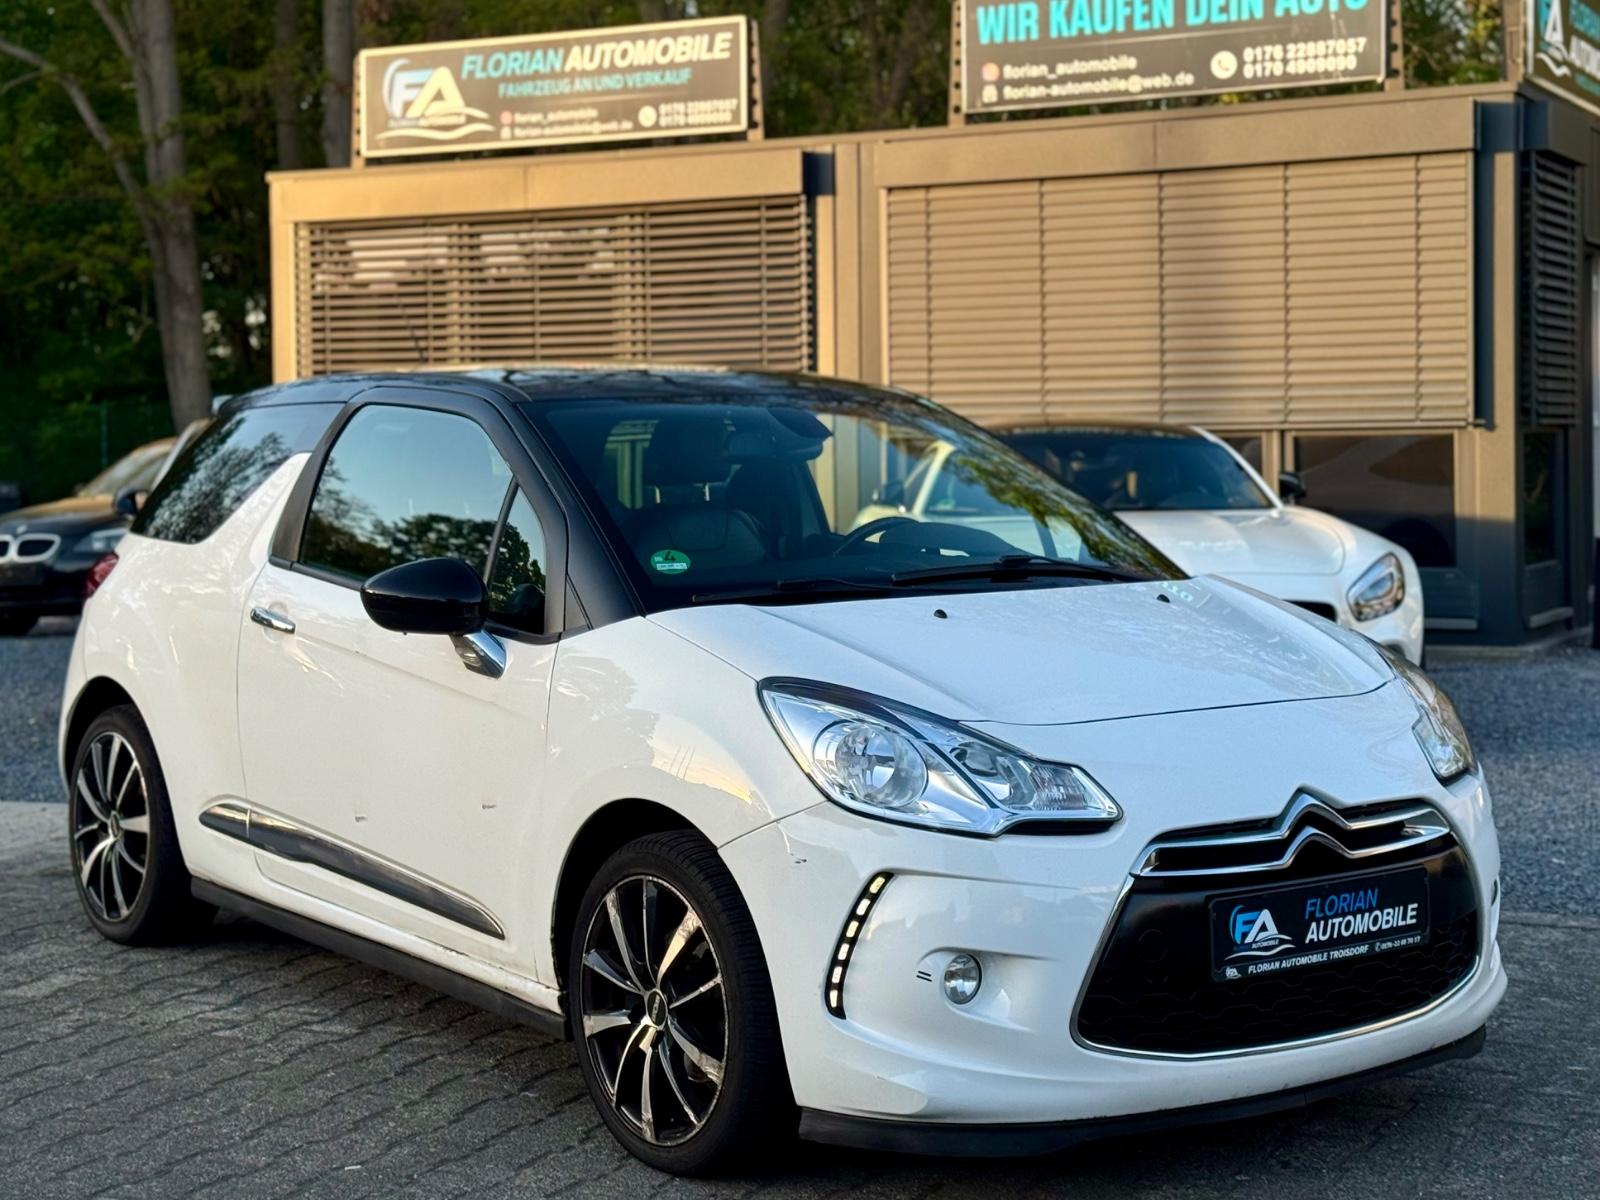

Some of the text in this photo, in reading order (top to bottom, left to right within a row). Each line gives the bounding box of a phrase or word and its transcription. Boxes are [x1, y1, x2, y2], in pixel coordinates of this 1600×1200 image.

[976, 1, 1039, 45] WIR
[1049, 0, 1175, 39] KAUFEN
[1185, 0, 1264, 27] DEIN
[461, 32, 733, 80] FLORIAN AUTOMOBILE
[498, 67, 693, 98] FAHRZEUG AN UND VERKAUF
[1305, 888, 1378, 920] FLORIAN
[1234, 908, 1279, 945] FA
[1305, 903, 1418, 944] AUTOMOBILE
[1248, 961, 1280, 975] FLORIAN
[1281, 951, 1328, 969] AUTOMOBILE
[1329, 944, 1369, 960] TROISDORF
